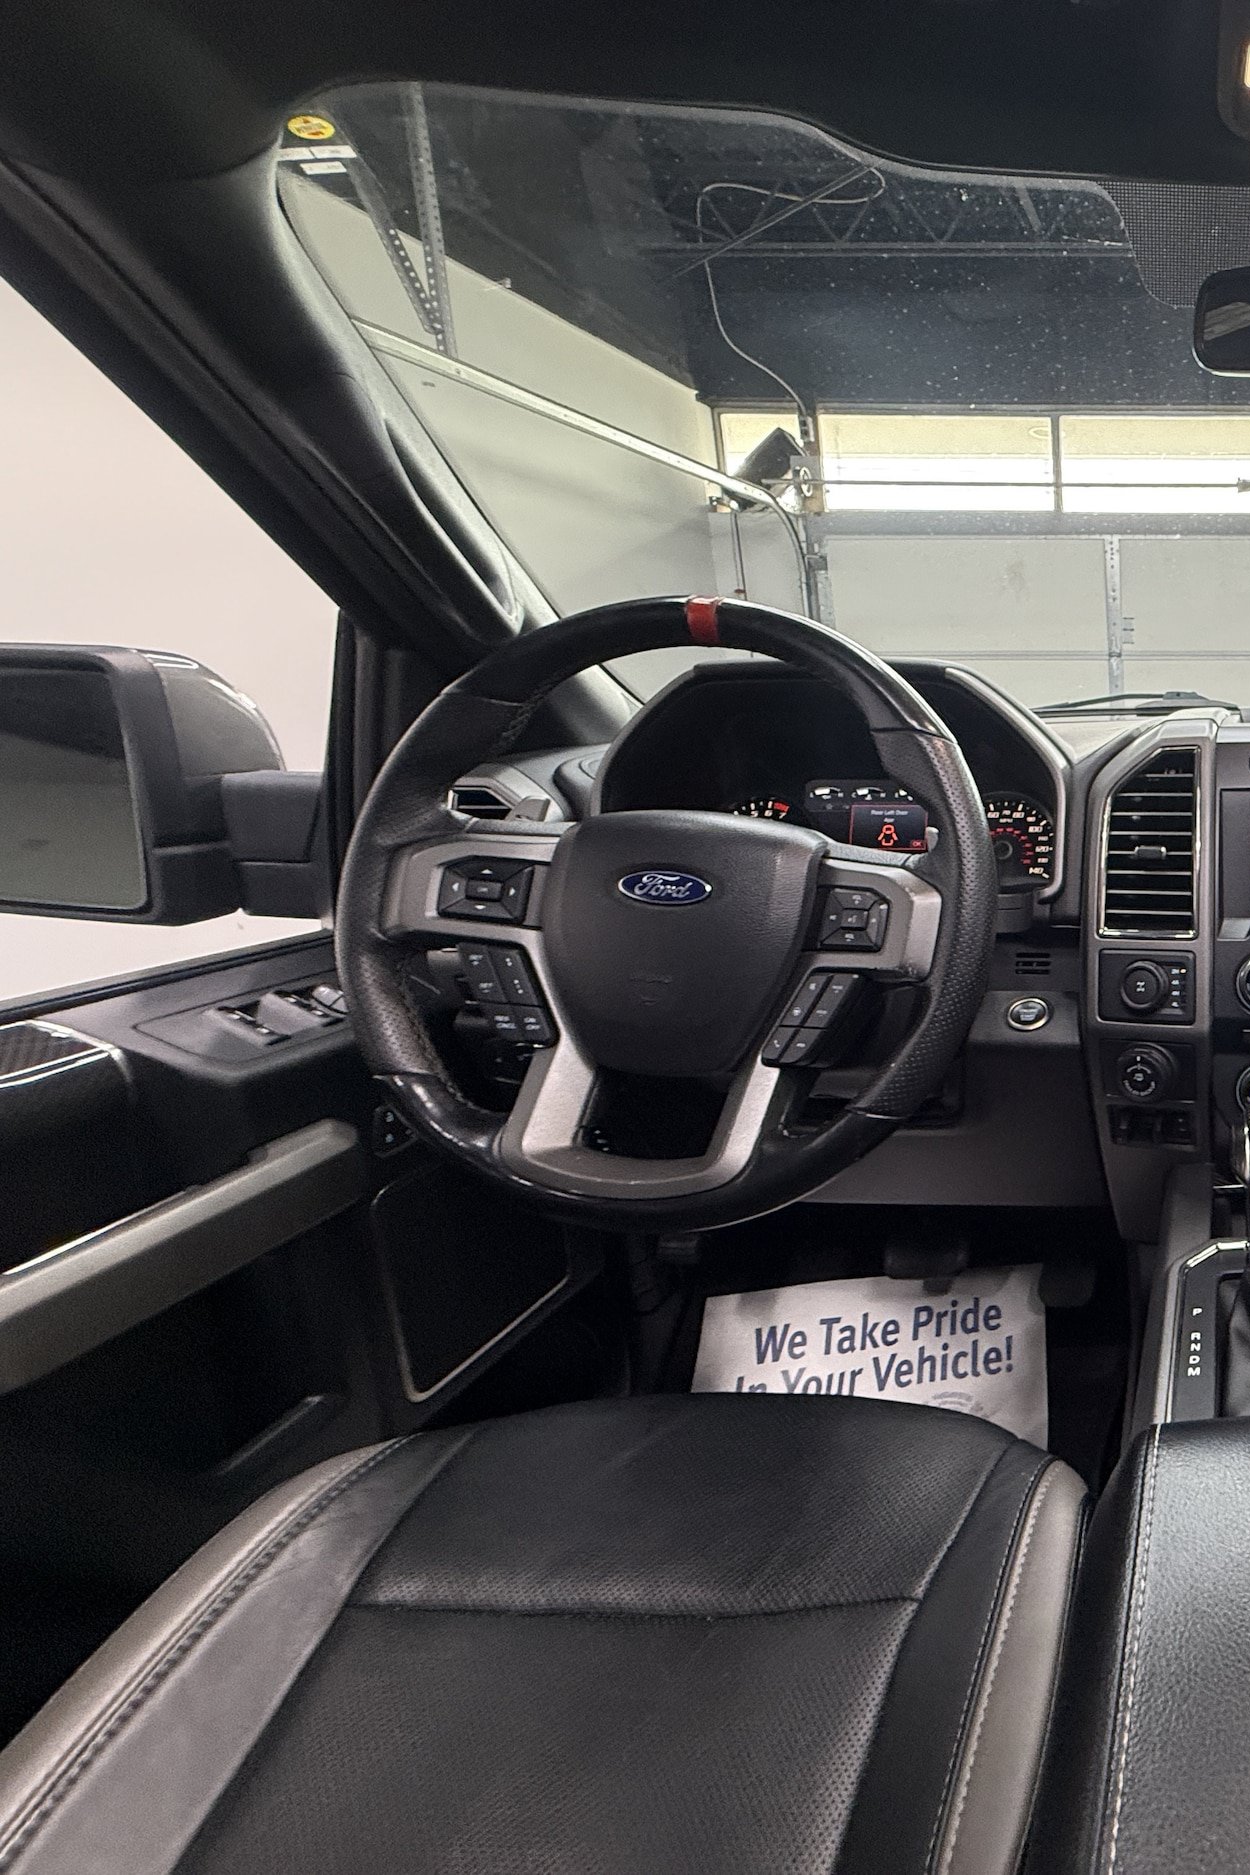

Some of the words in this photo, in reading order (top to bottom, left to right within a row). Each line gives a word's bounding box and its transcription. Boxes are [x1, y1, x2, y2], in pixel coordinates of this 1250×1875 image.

[634, 873, 693, 898] Ford
[1193, 1308, 1203, 1316] P
[755, 1324, 807, 1365] We
[820, 1313, 899, 1355] Take
[912, 1297, 1002, 1341] Pride
[1191, 1332, 1201, 1340] R
[1190, 1343, 1201, 1351] N
[872, 1336, 1014, 1391] Vehicle!
[1189, 1355, 1200, 1364] D
[1187, 1367, 1200, 1376] M
